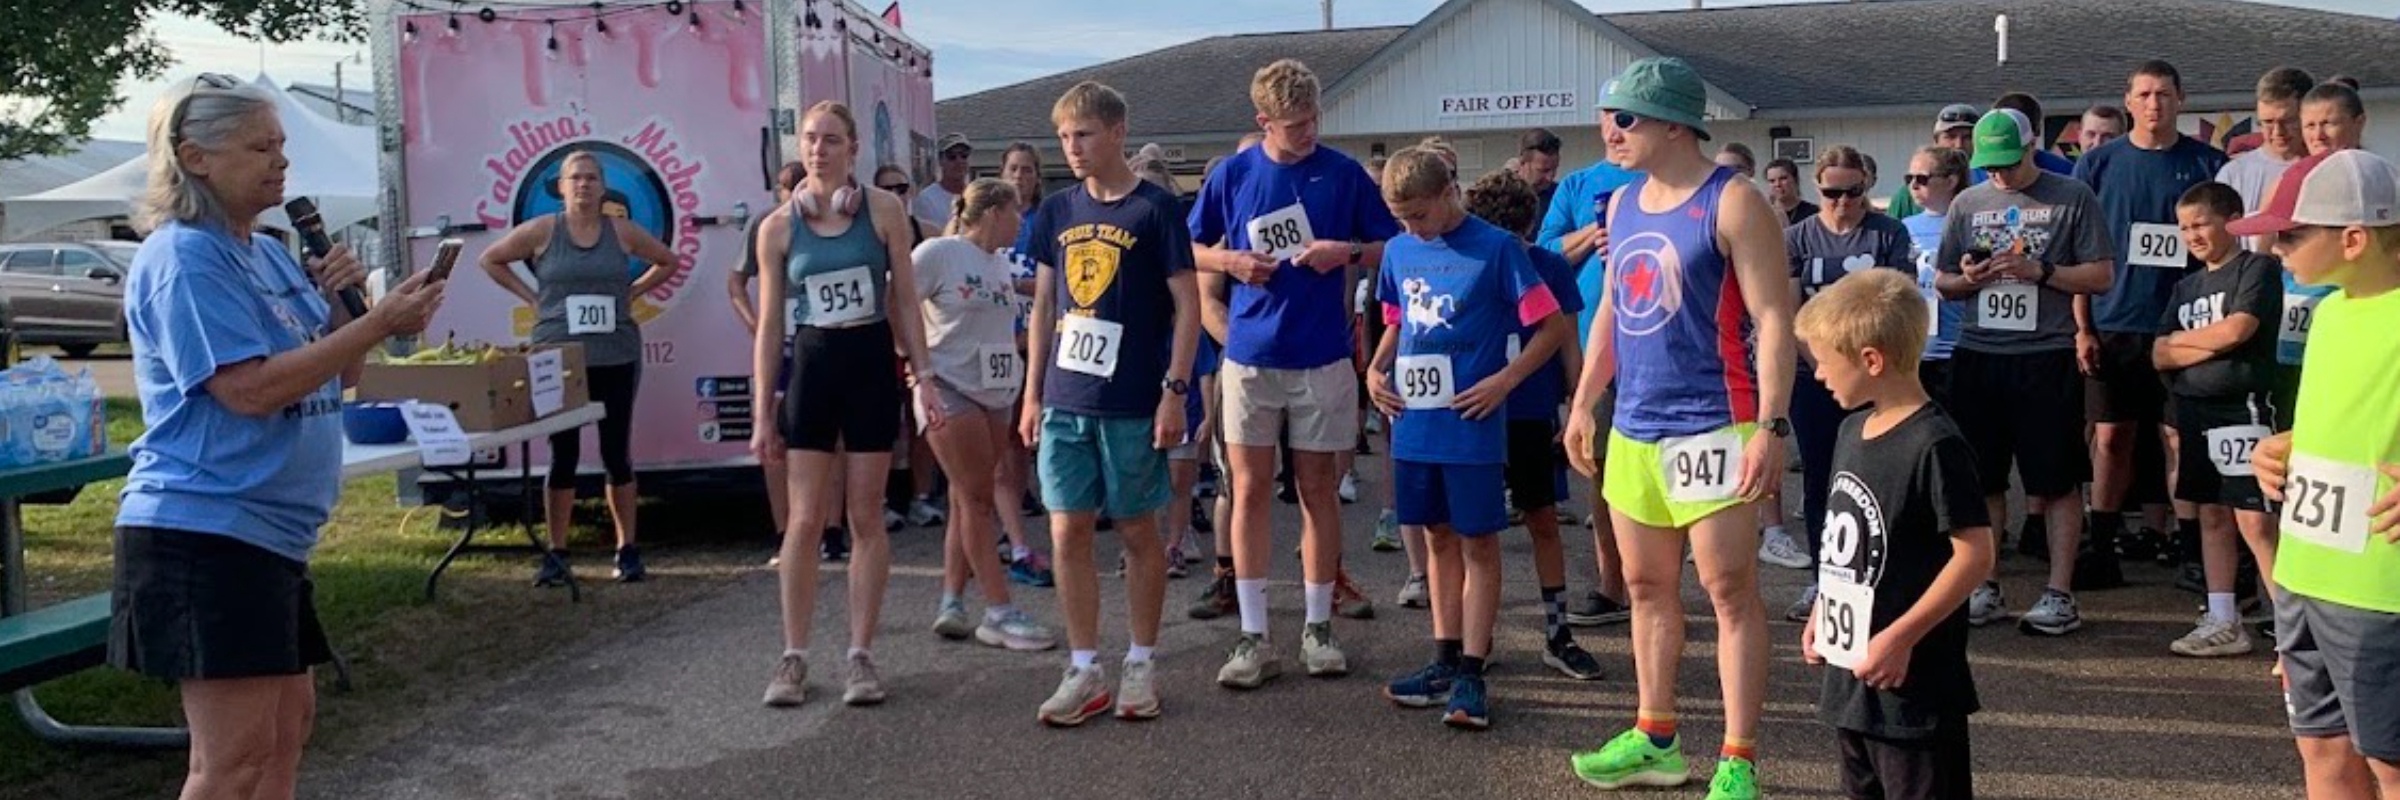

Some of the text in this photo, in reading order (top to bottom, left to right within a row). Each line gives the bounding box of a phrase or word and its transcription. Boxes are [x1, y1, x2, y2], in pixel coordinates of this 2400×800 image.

[1442, 93, 1574, 113] FAIR OFFICE
[476, 116, 592, 230] Catalina's
[1057, 223, 1138, 250] TRUE TEAM
[1258, 217, 1302, 255] 388
[2140, 232, 2178, 258] 920
[819, 279, 864, 313] 954
[1988, 293, 2027, 320] 996
[578, 304, 607, 325] 201
[2288, 305, 2309, 332] 92
[1066, 329, 1109, 365] 202
[989, 353, 1012, 378] 937
[1405, 366, 1441, 398] 939
[1677, 447, 1727, 488] 947
[2291, 474, 2346, 535] 231
